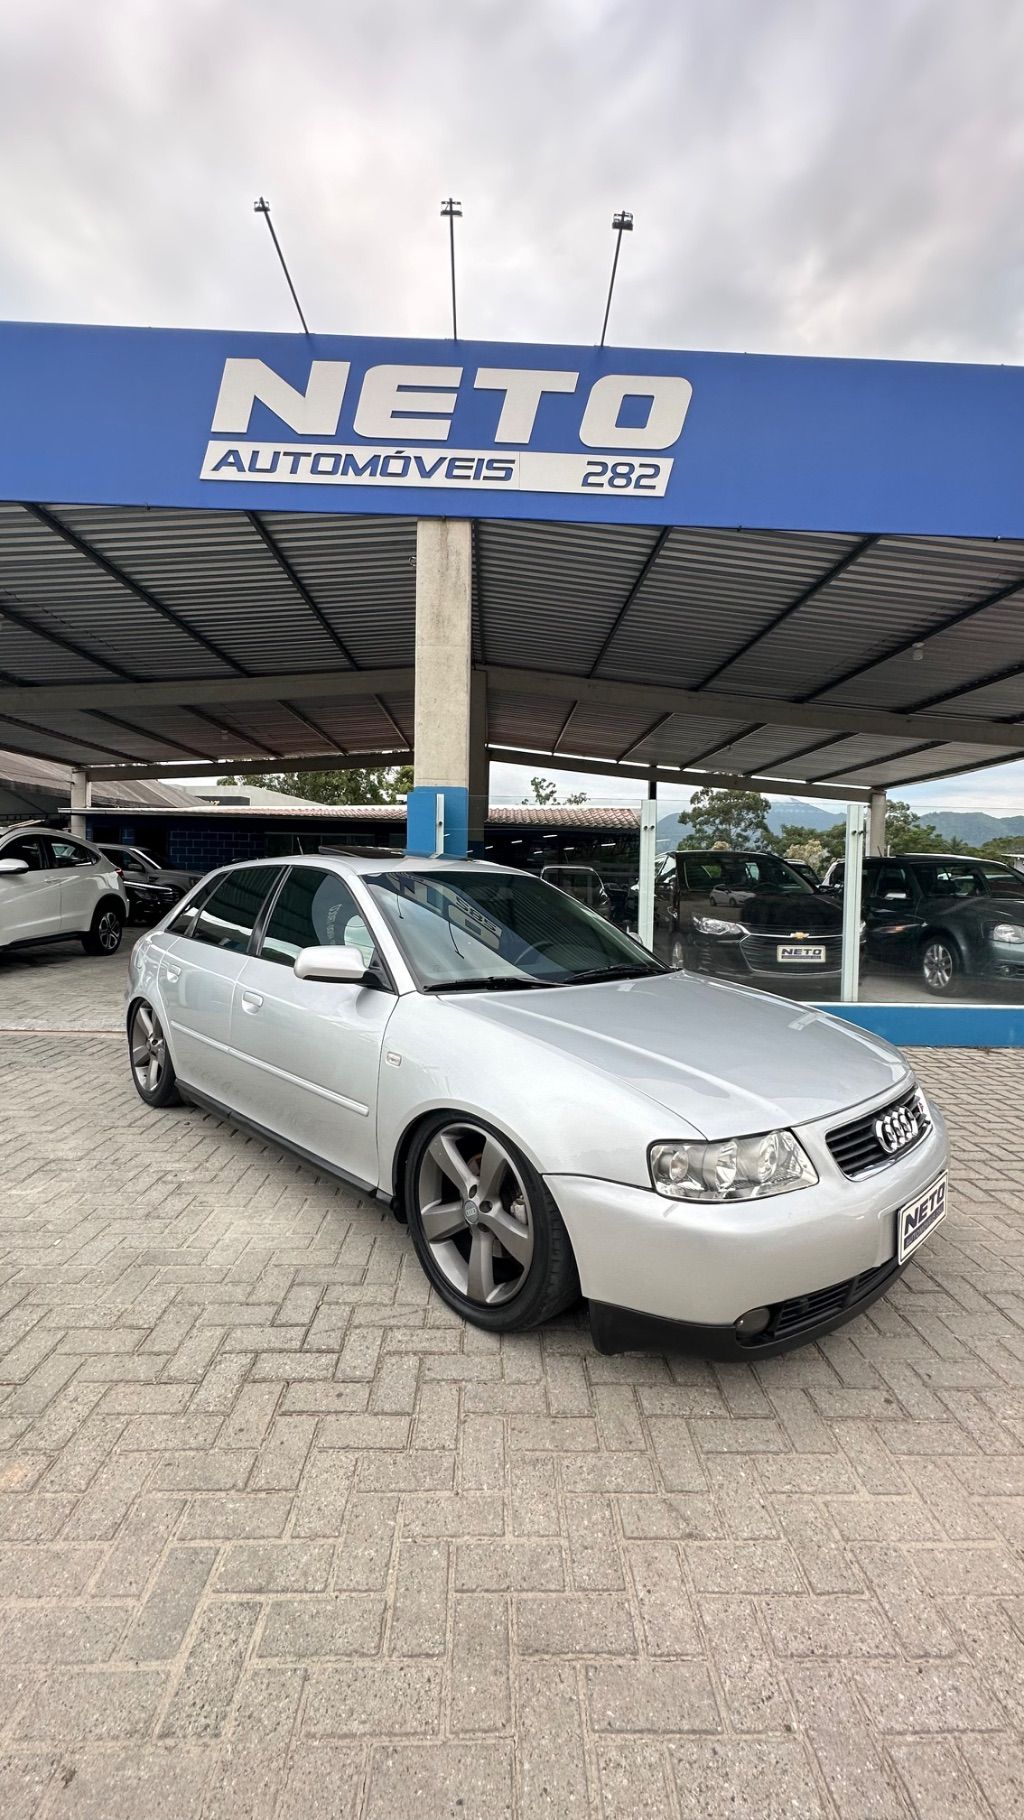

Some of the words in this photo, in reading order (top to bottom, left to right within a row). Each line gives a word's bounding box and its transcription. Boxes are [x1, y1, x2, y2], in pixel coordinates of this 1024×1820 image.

[211, 358, 693, 450] NETO
[211, 449, 516, 482] AUTOMÓVEIS
[581, 460, 661, 490] 282
[904, 1182, 945, 1236] NETO
